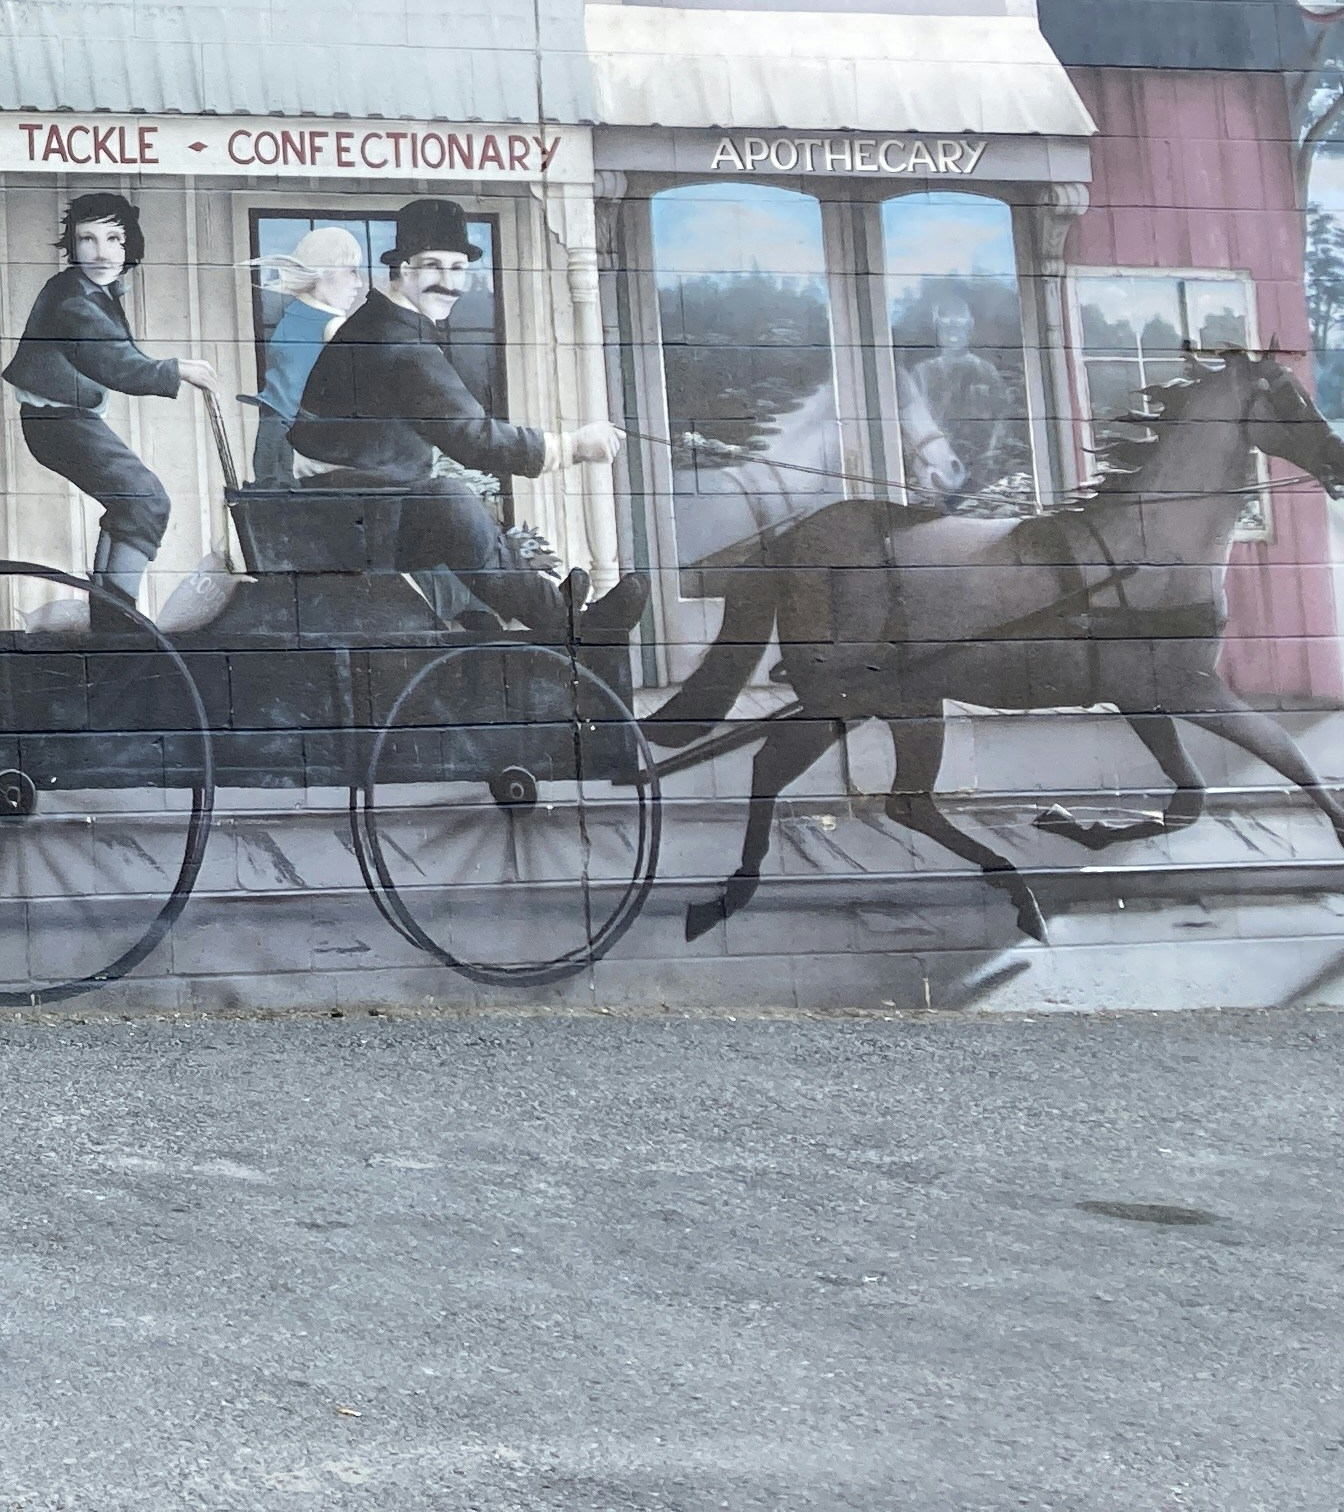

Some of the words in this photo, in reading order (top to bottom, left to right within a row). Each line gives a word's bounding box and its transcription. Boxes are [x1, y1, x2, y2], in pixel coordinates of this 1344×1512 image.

[18, 123, 159, 164] TACKLE
[227, 128, 562, 173] CONFECTIONARY
[710, 138, 988, 175] APOTHECARY
